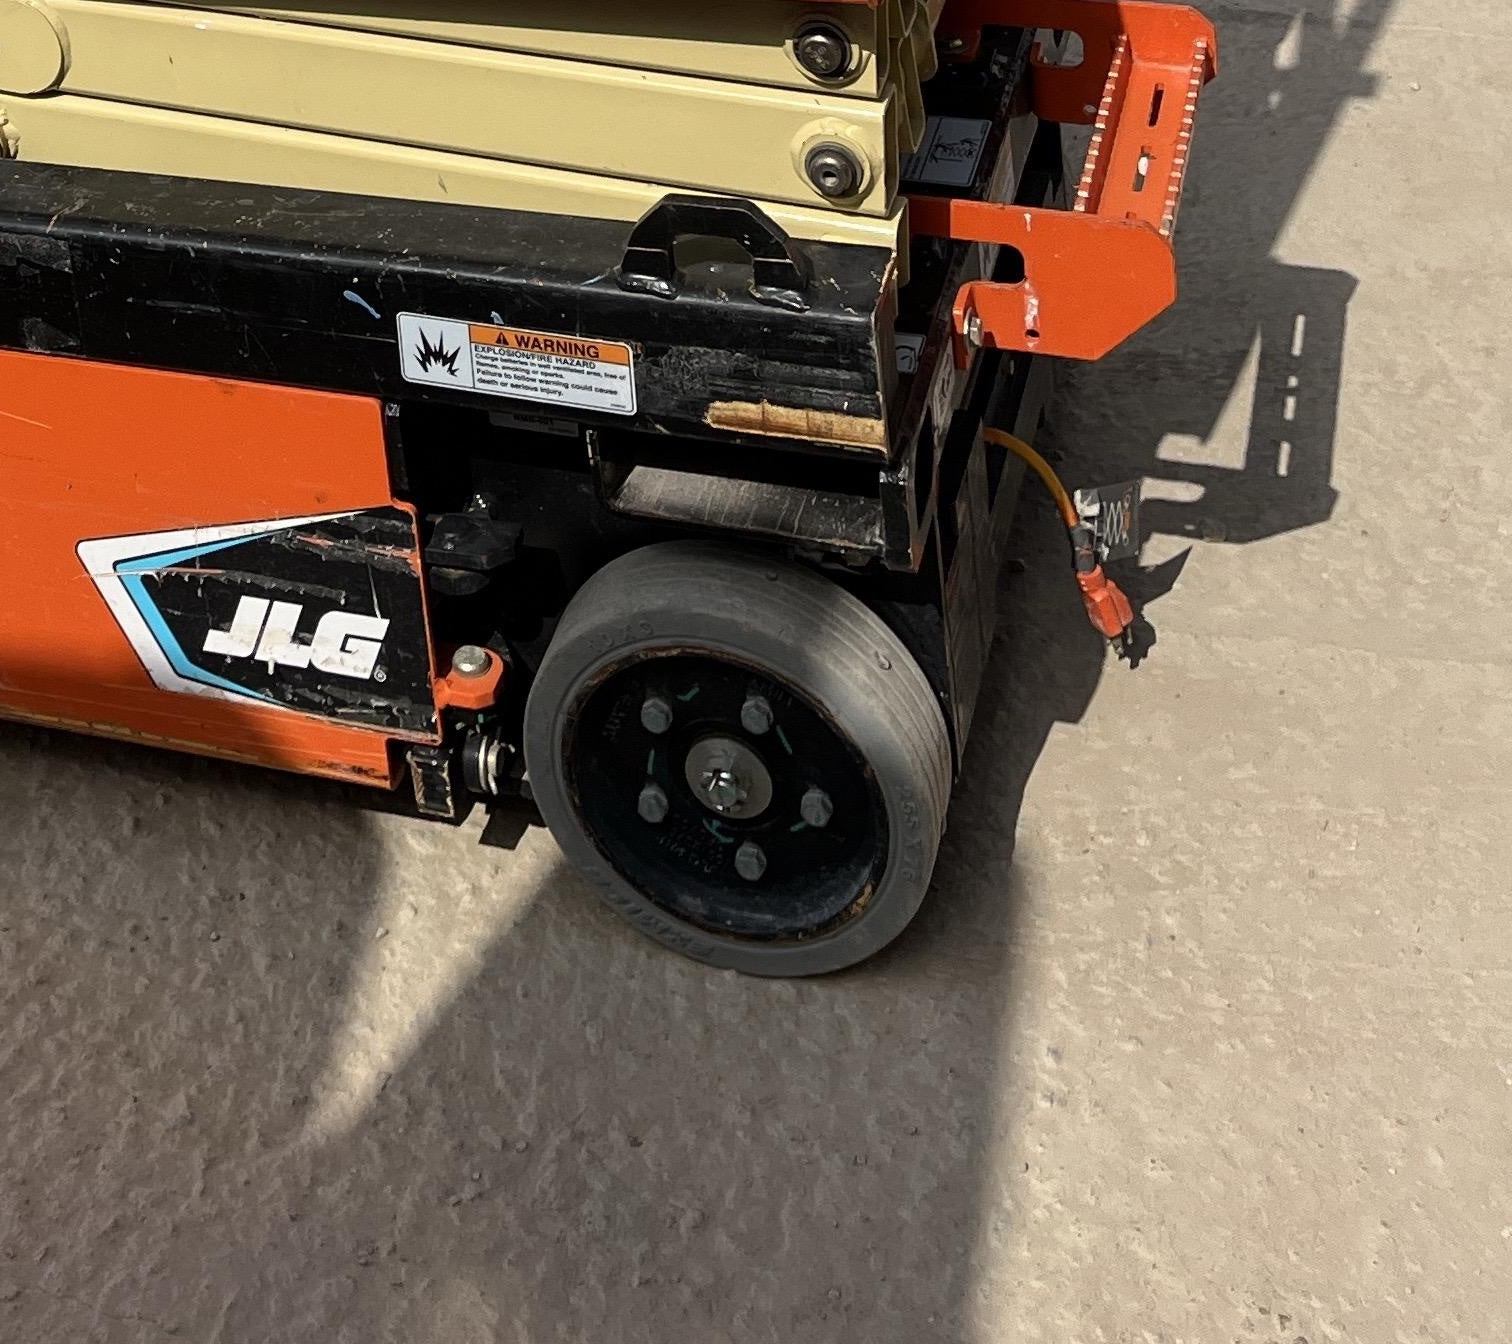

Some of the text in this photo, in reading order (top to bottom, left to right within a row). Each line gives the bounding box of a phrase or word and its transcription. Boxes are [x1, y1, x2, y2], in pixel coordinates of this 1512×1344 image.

[475, 344, 596, 370] EXPLOSION/FIRE HAZARD
[475, 353, 499, 362] Charge
[514, 334, 600, 359] WARNING
[477, 368, 503, 378] Failure
[514, 374, 537, 383] follow
[203, 595, 390, 680] JLG
